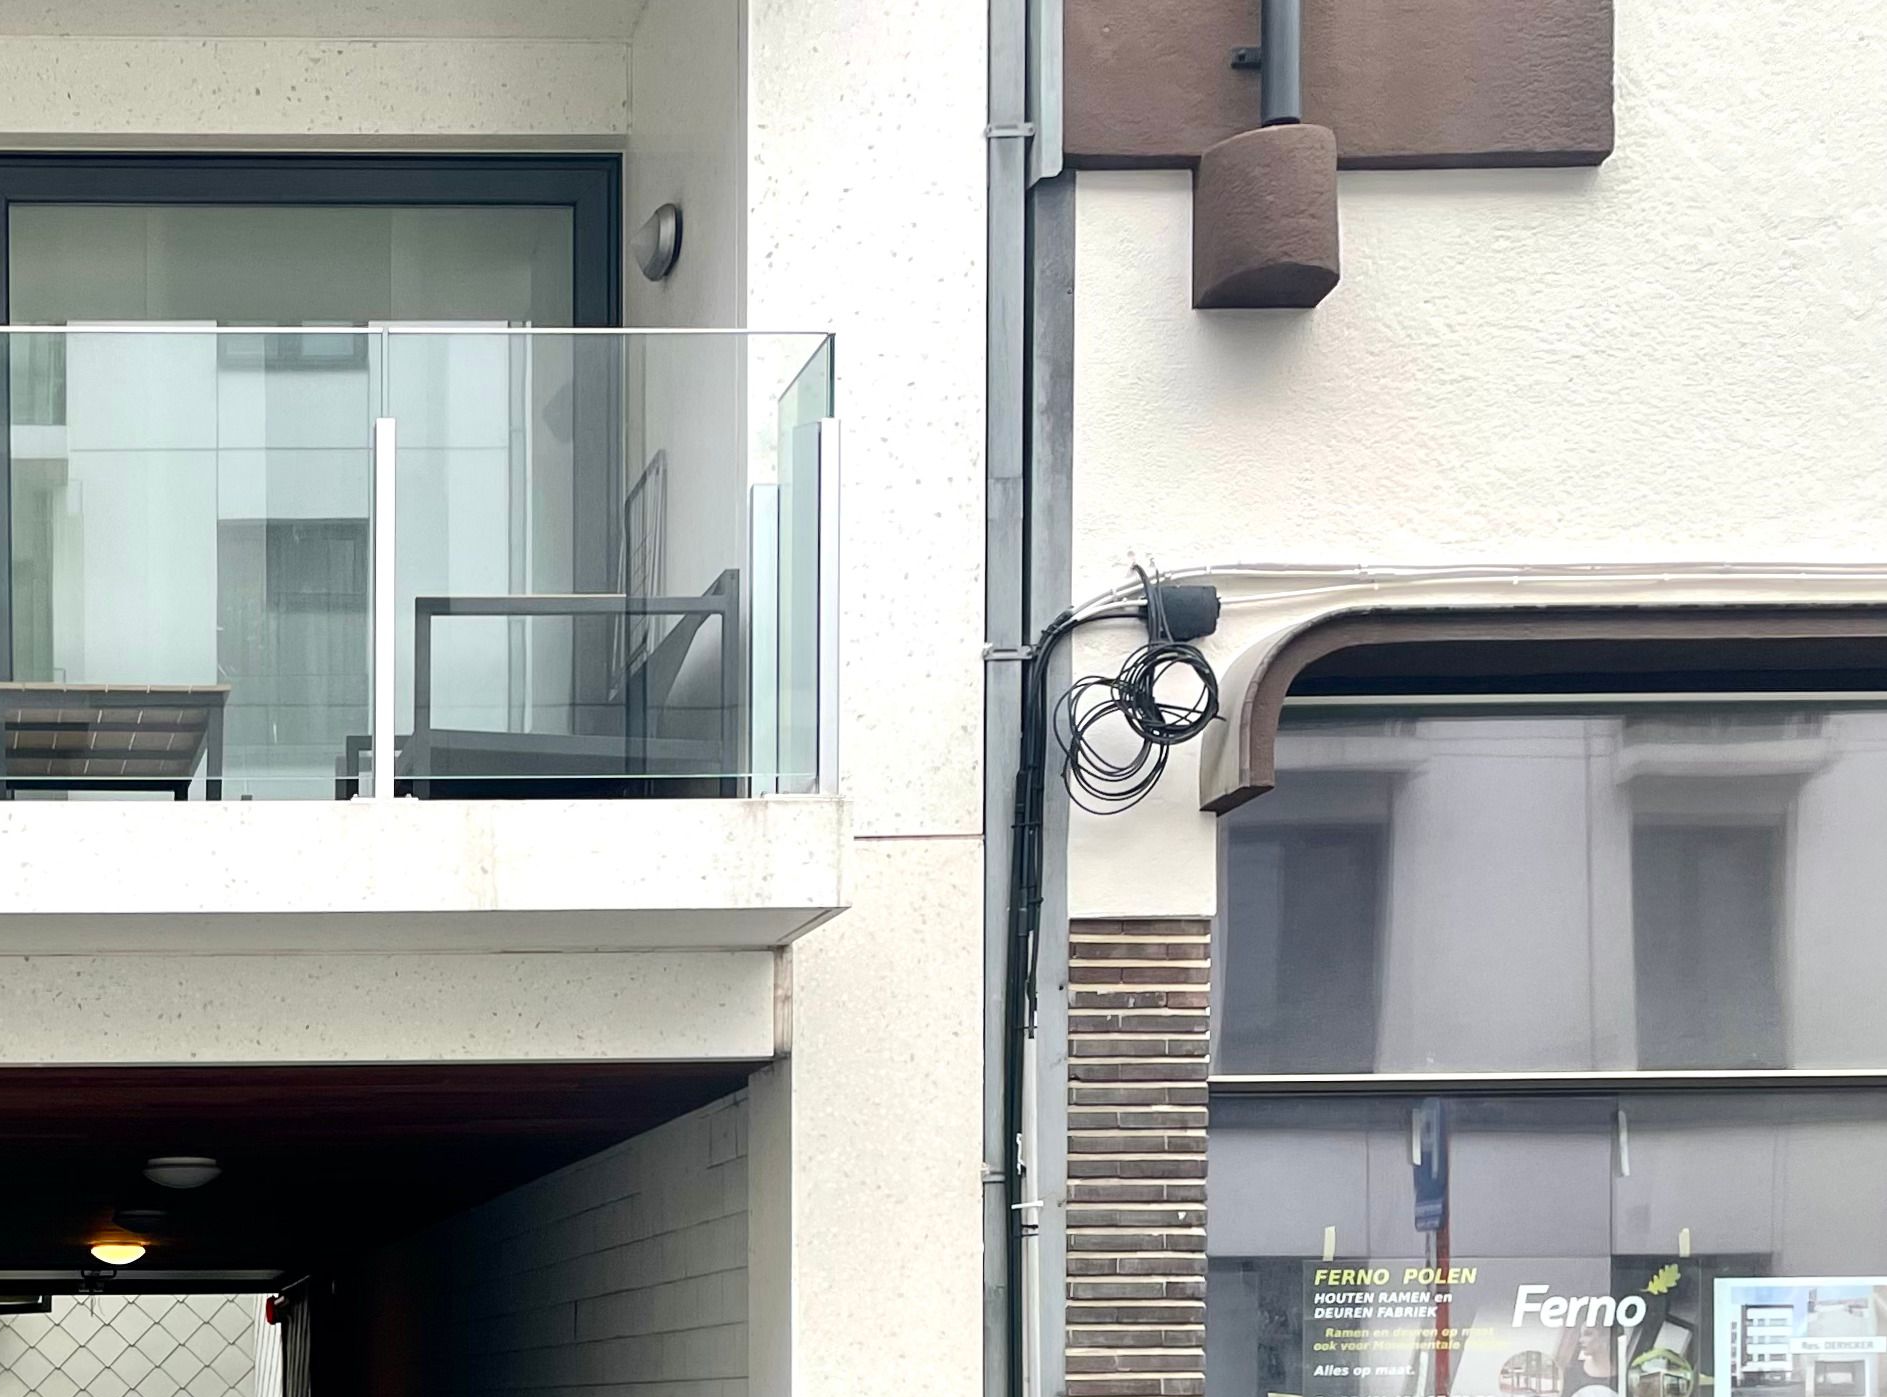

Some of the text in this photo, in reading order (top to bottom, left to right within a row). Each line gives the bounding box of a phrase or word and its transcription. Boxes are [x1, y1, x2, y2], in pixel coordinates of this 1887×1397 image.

[1314, 1267, 1477, 1286] FERNO POLEN
[1314, 1292, 1453, 1304] HOUTEN RAMEN en
[1314, 1306, 1438, 1319] DEUREN FABRIEK
[1512, 1284, 1646, 1328] Ferno
[1325, 1328, 1369, 1338] Ramen
[1374, 1328, 1389, 1337] en
[1442, 1328, 1457, 1338] op
[1314, 1341, 1336, 1351] ook
[1340, 1342, 1369, 1351] voor
[1314, 1365, 1415, 1378] Alles op maat.
